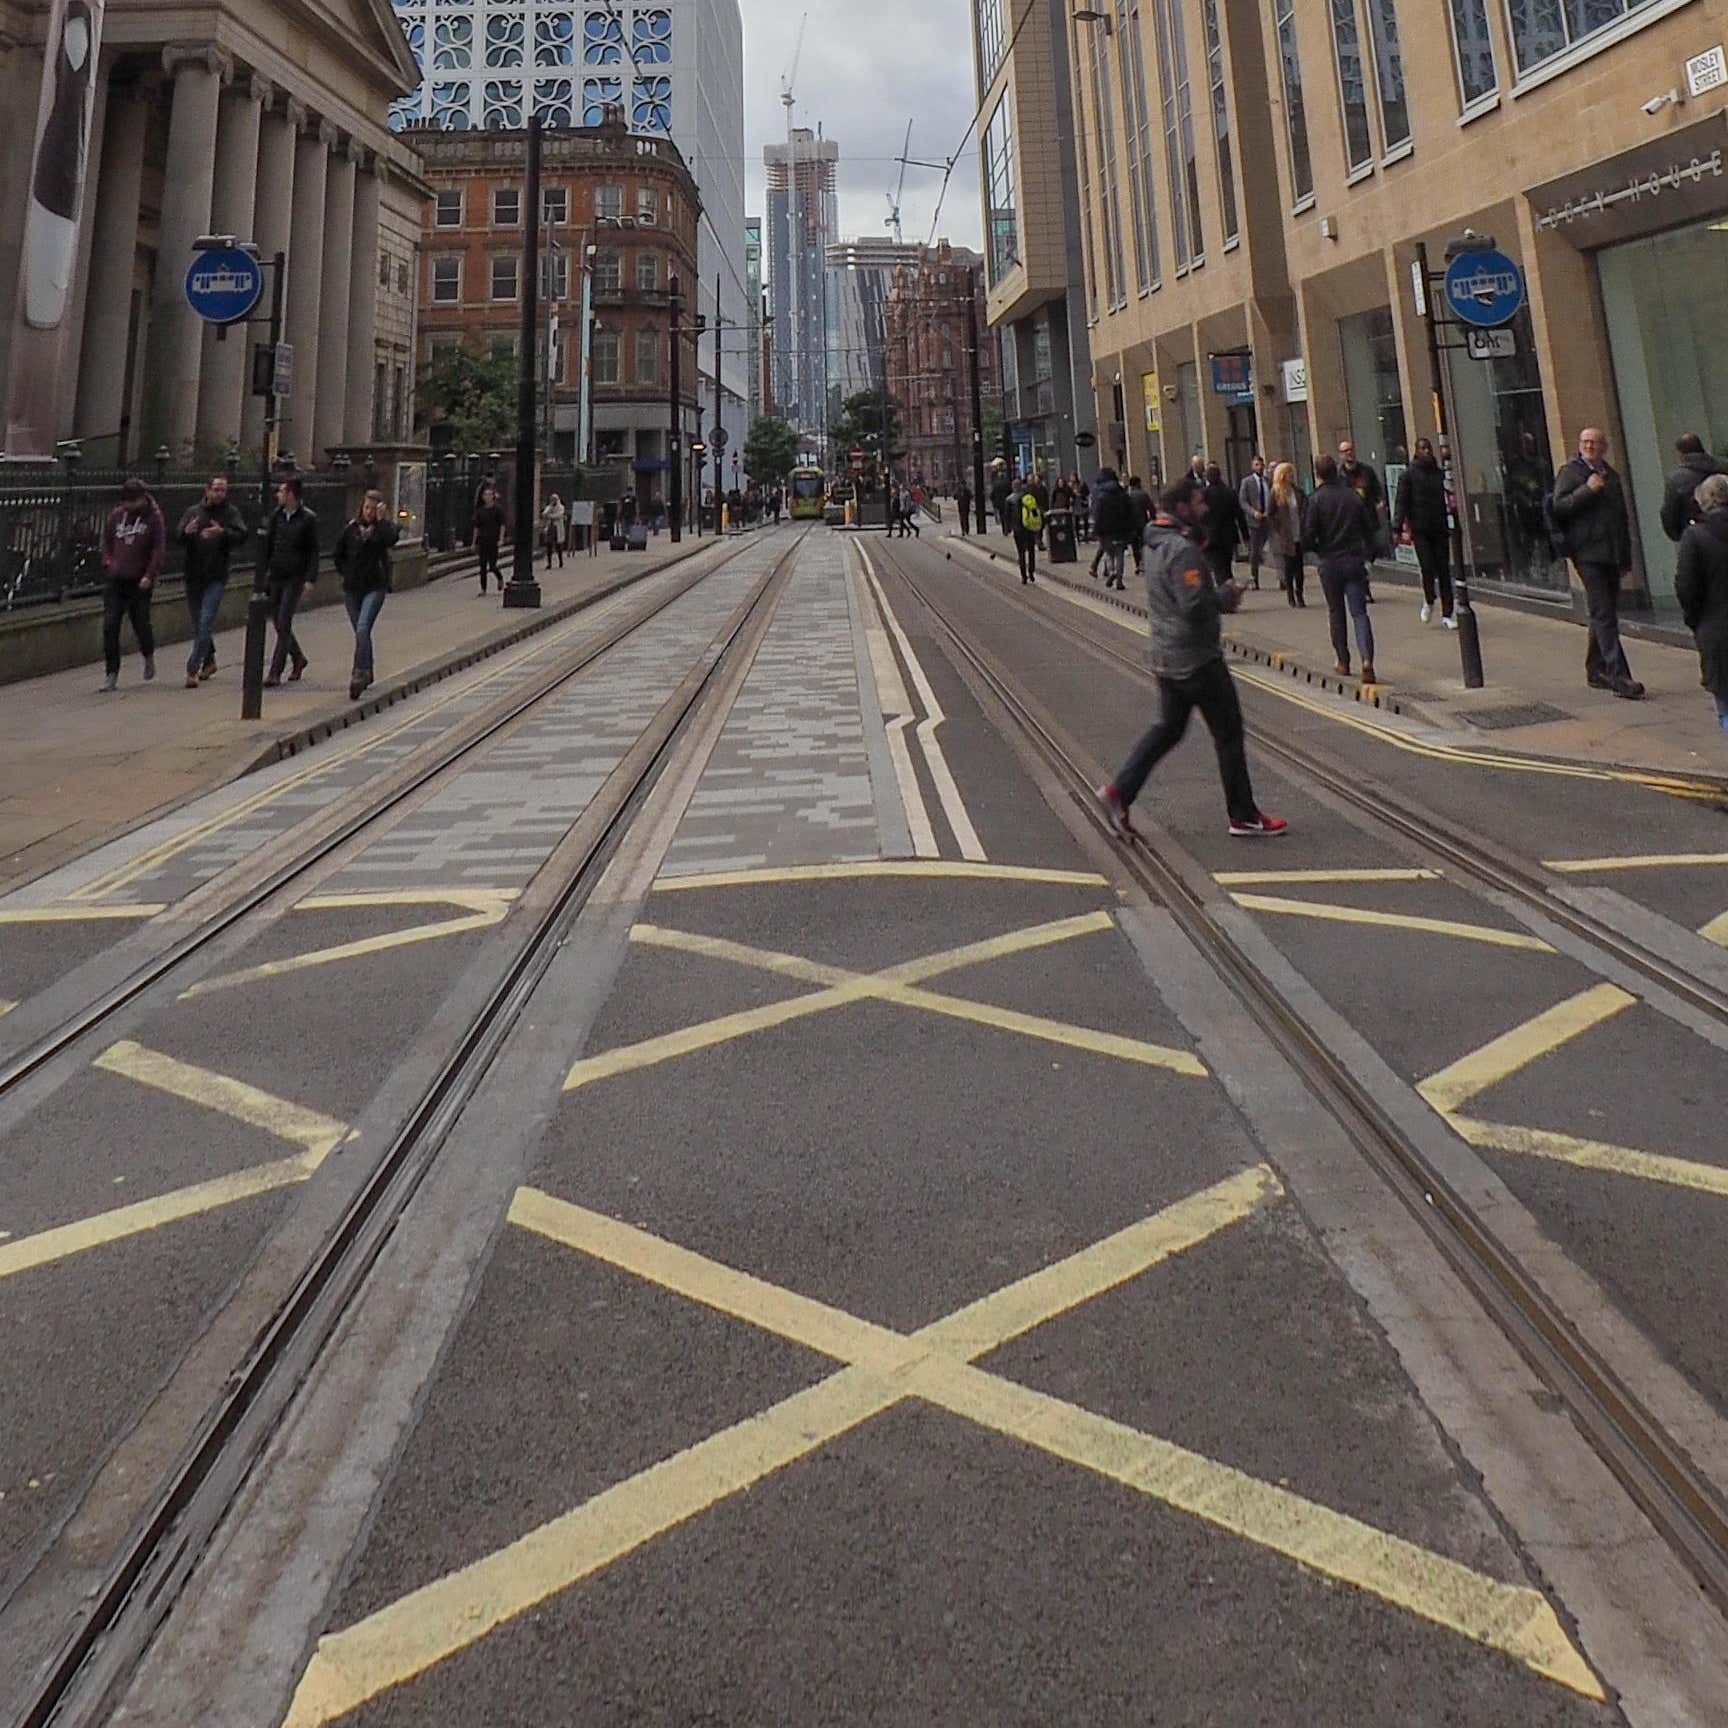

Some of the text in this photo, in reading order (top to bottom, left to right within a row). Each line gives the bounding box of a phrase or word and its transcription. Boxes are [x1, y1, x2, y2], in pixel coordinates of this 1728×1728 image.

[1690, 52, 1719, 74] MOSLEY
[1694, 67, 1722, 90] STREET
[1629, 150, 1723, 203] HOUSE
